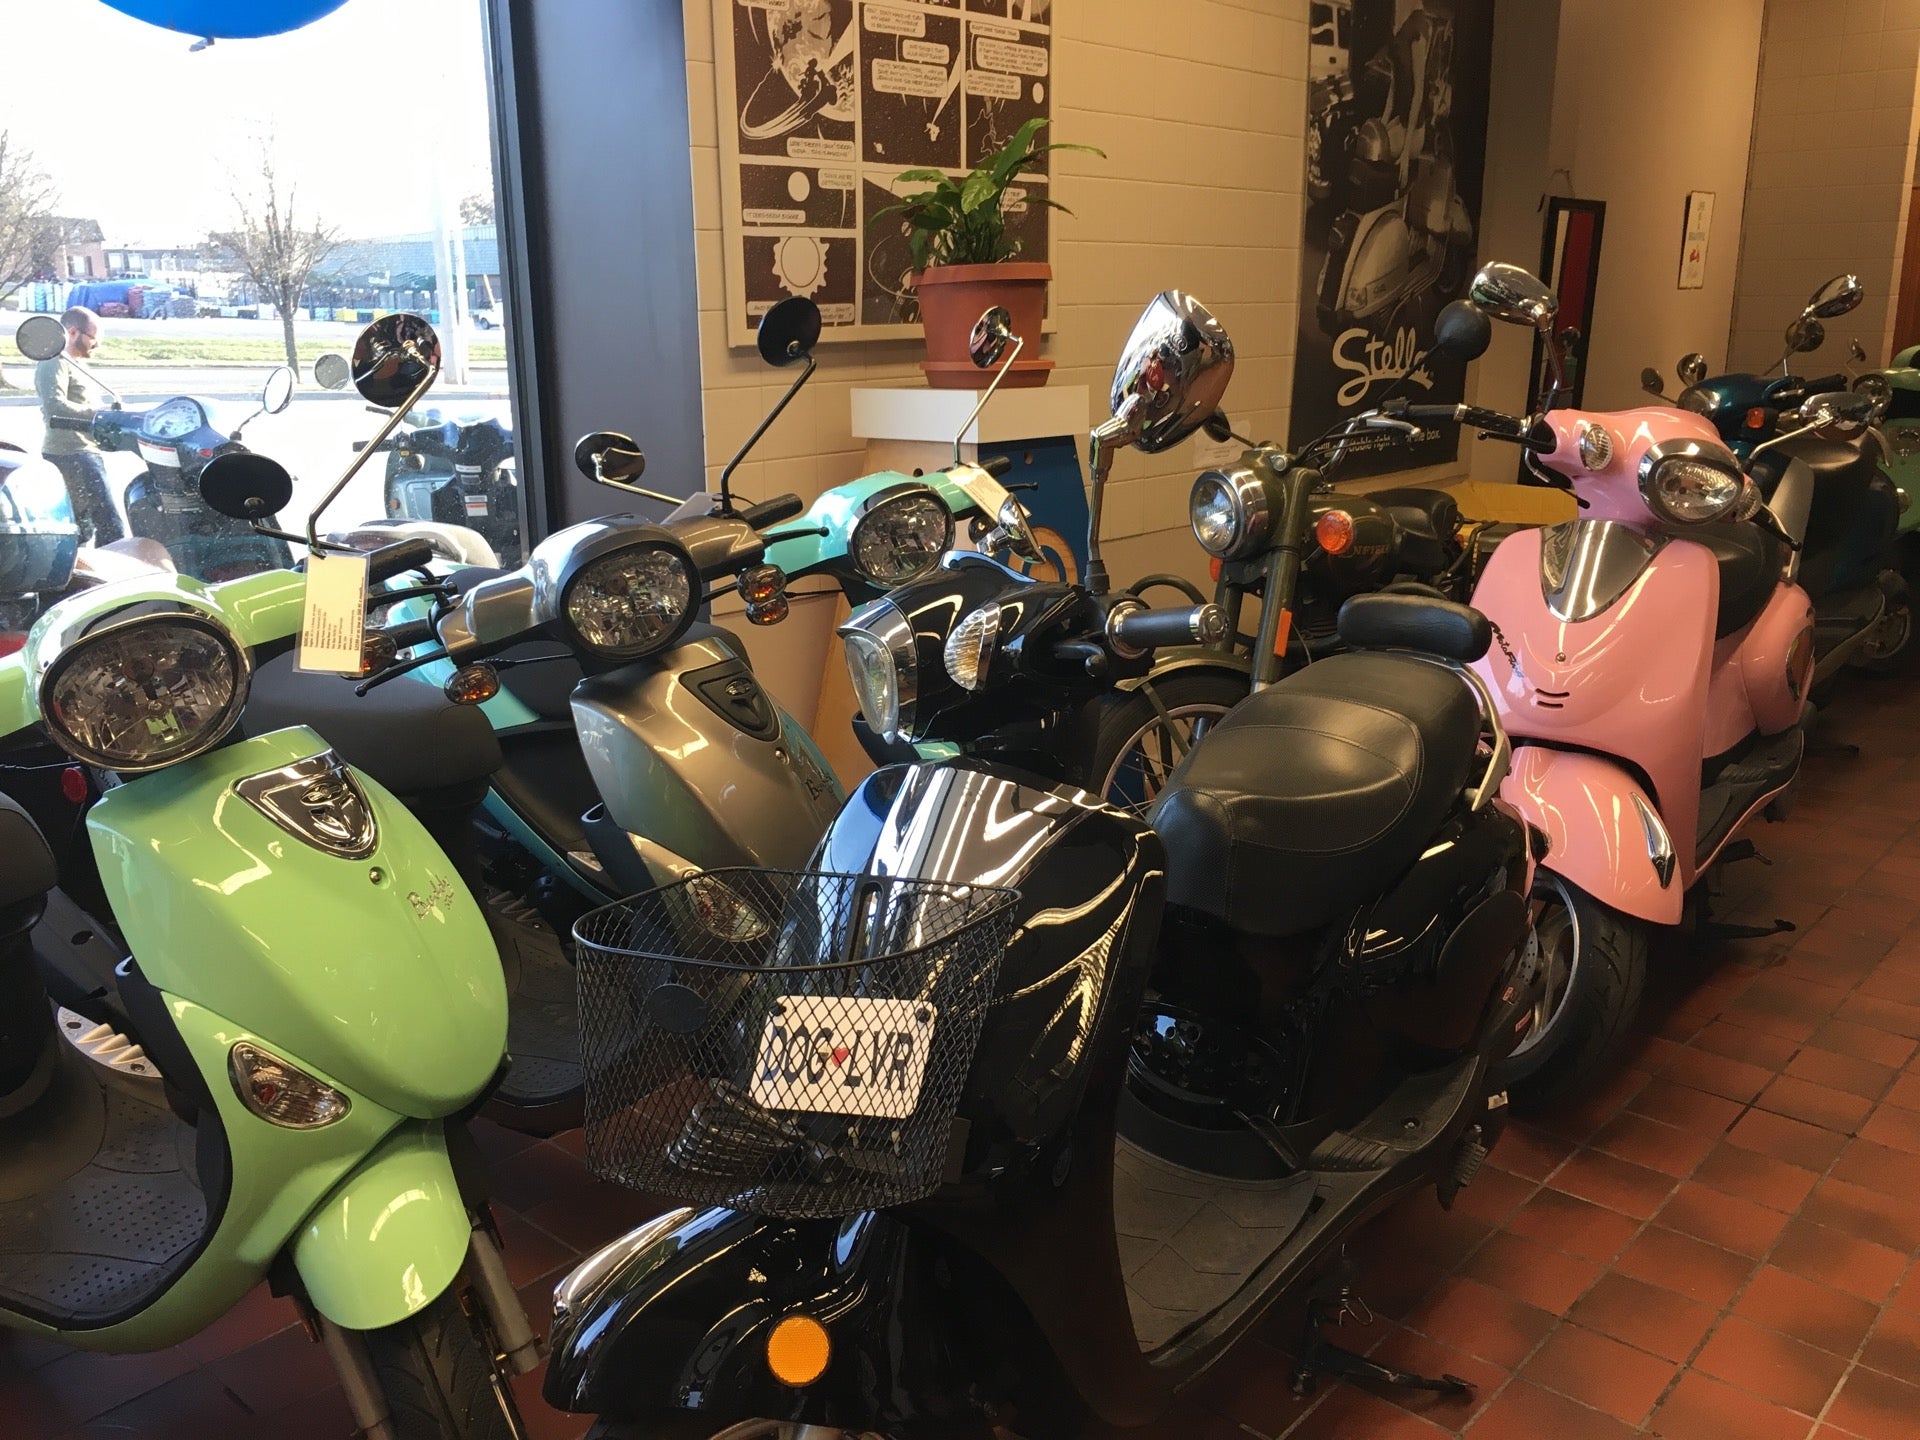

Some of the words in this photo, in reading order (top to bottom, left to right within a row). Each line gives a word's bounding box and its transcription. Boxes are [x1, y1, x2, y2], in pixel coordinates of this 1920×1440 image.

[1332, 326, 1434, 407] Stella
[762, 1024, 835, 1085] DOG
[844, 1029, 914, 1092] LVR
